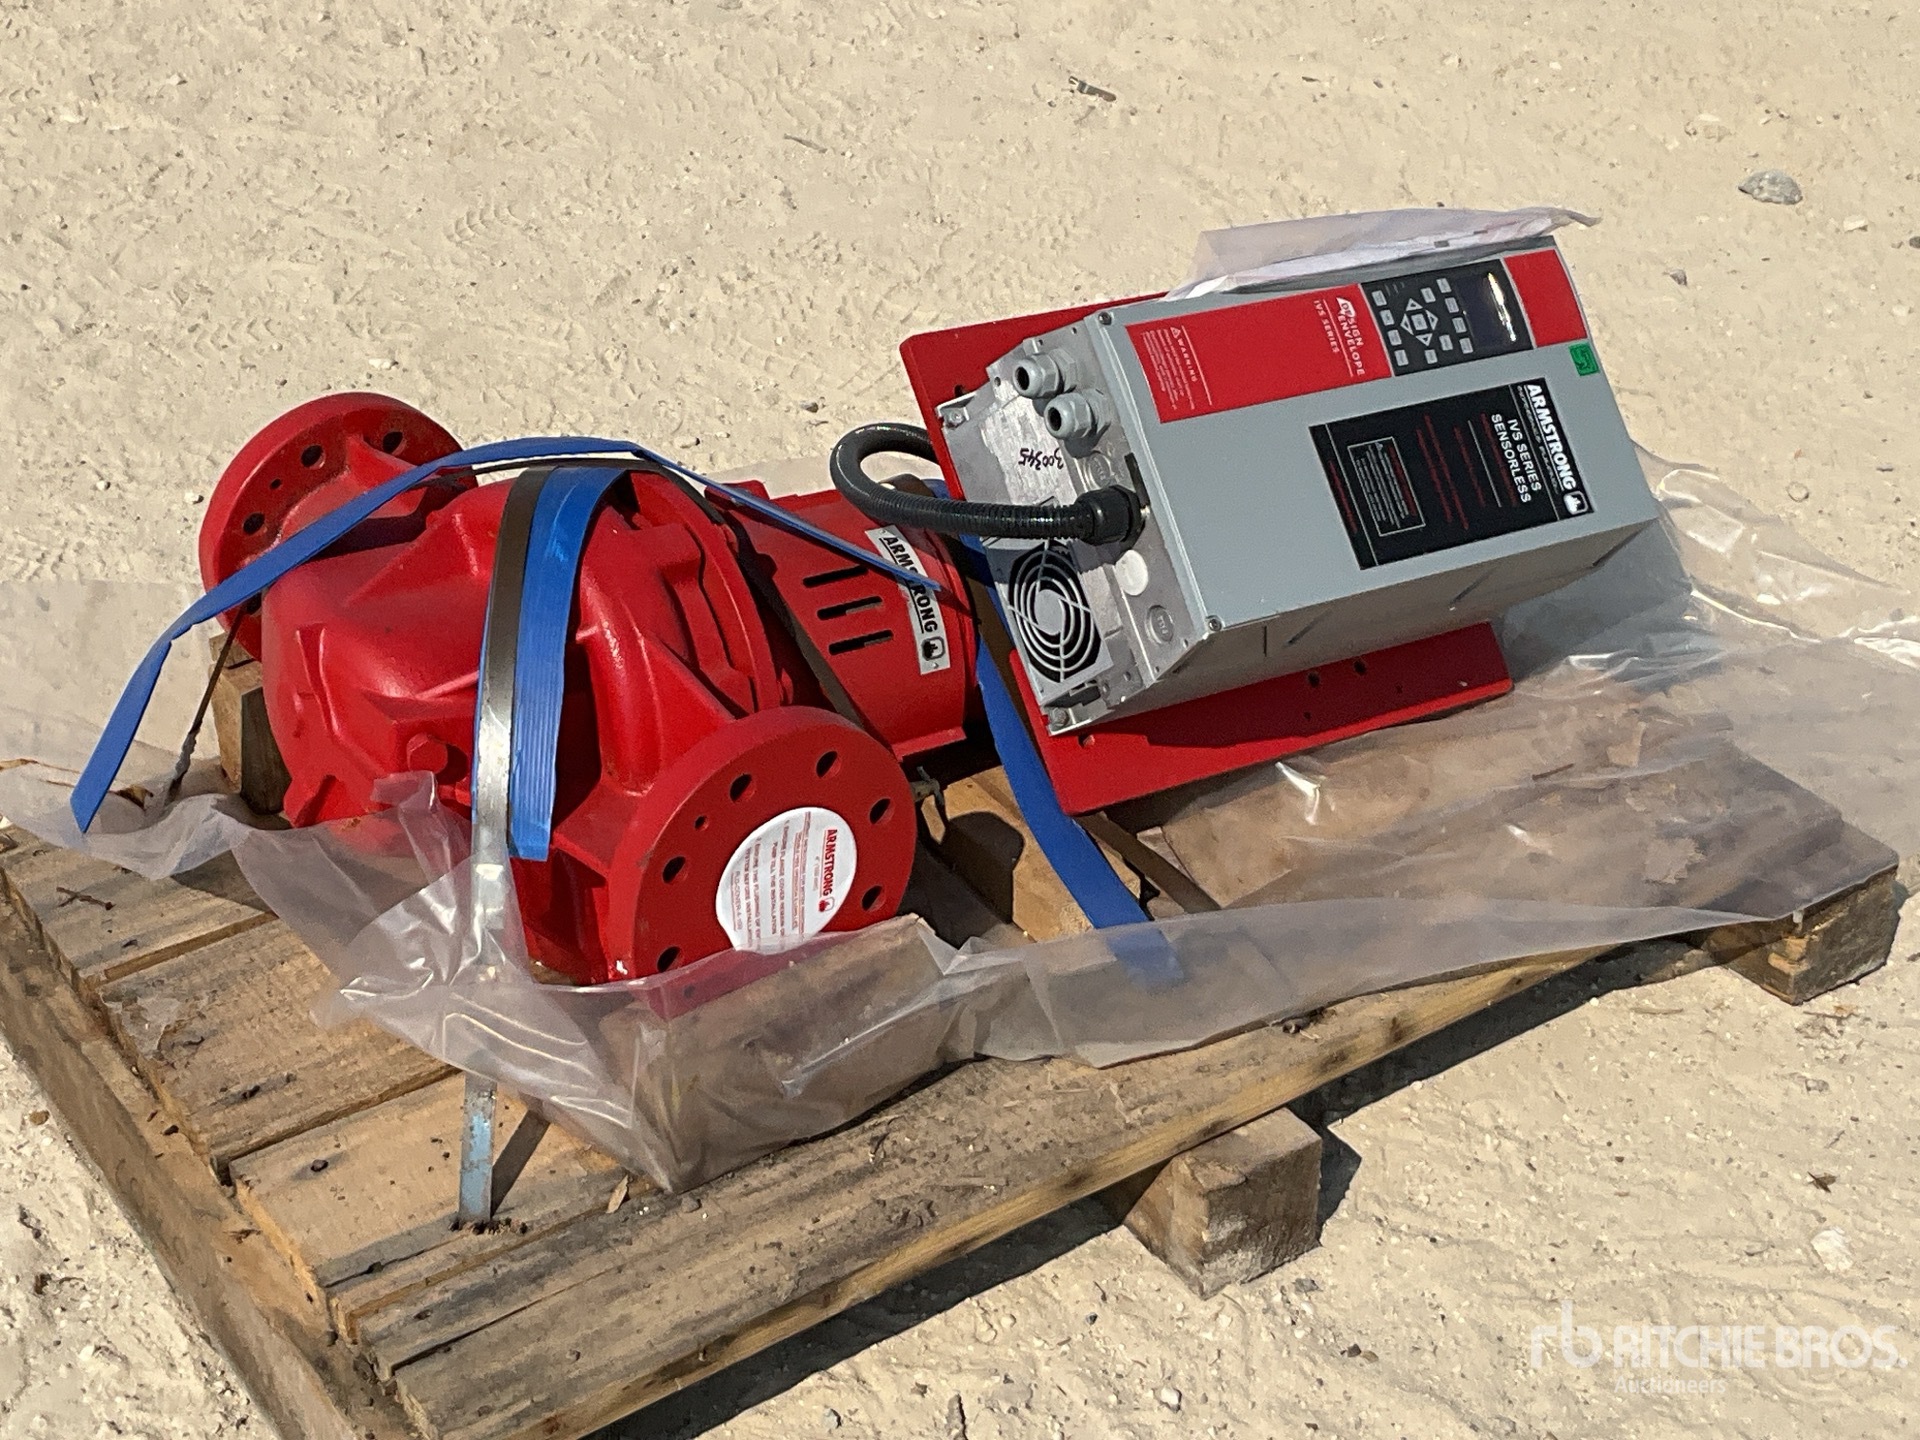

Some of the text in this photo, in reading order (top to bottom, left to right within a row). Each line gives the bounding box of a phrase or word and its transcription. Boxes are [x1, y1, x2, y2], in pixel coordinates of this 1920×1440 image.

[1176, 337, 1198, 382] WARNING
[1313, 299, 1340, 353] IVS SERIES
[1337, 314, 1365, 376] ENVELOPE
[1490, 413, 1531, 503] SENSORLESS
[1507, 418, 1523, 441] IVS
[1516, 443, 1542, 492] SERIES
[1526, 382, 1577, 491] ARMSTRONG
[823, 829, 837, 896] ARMSTRONG
